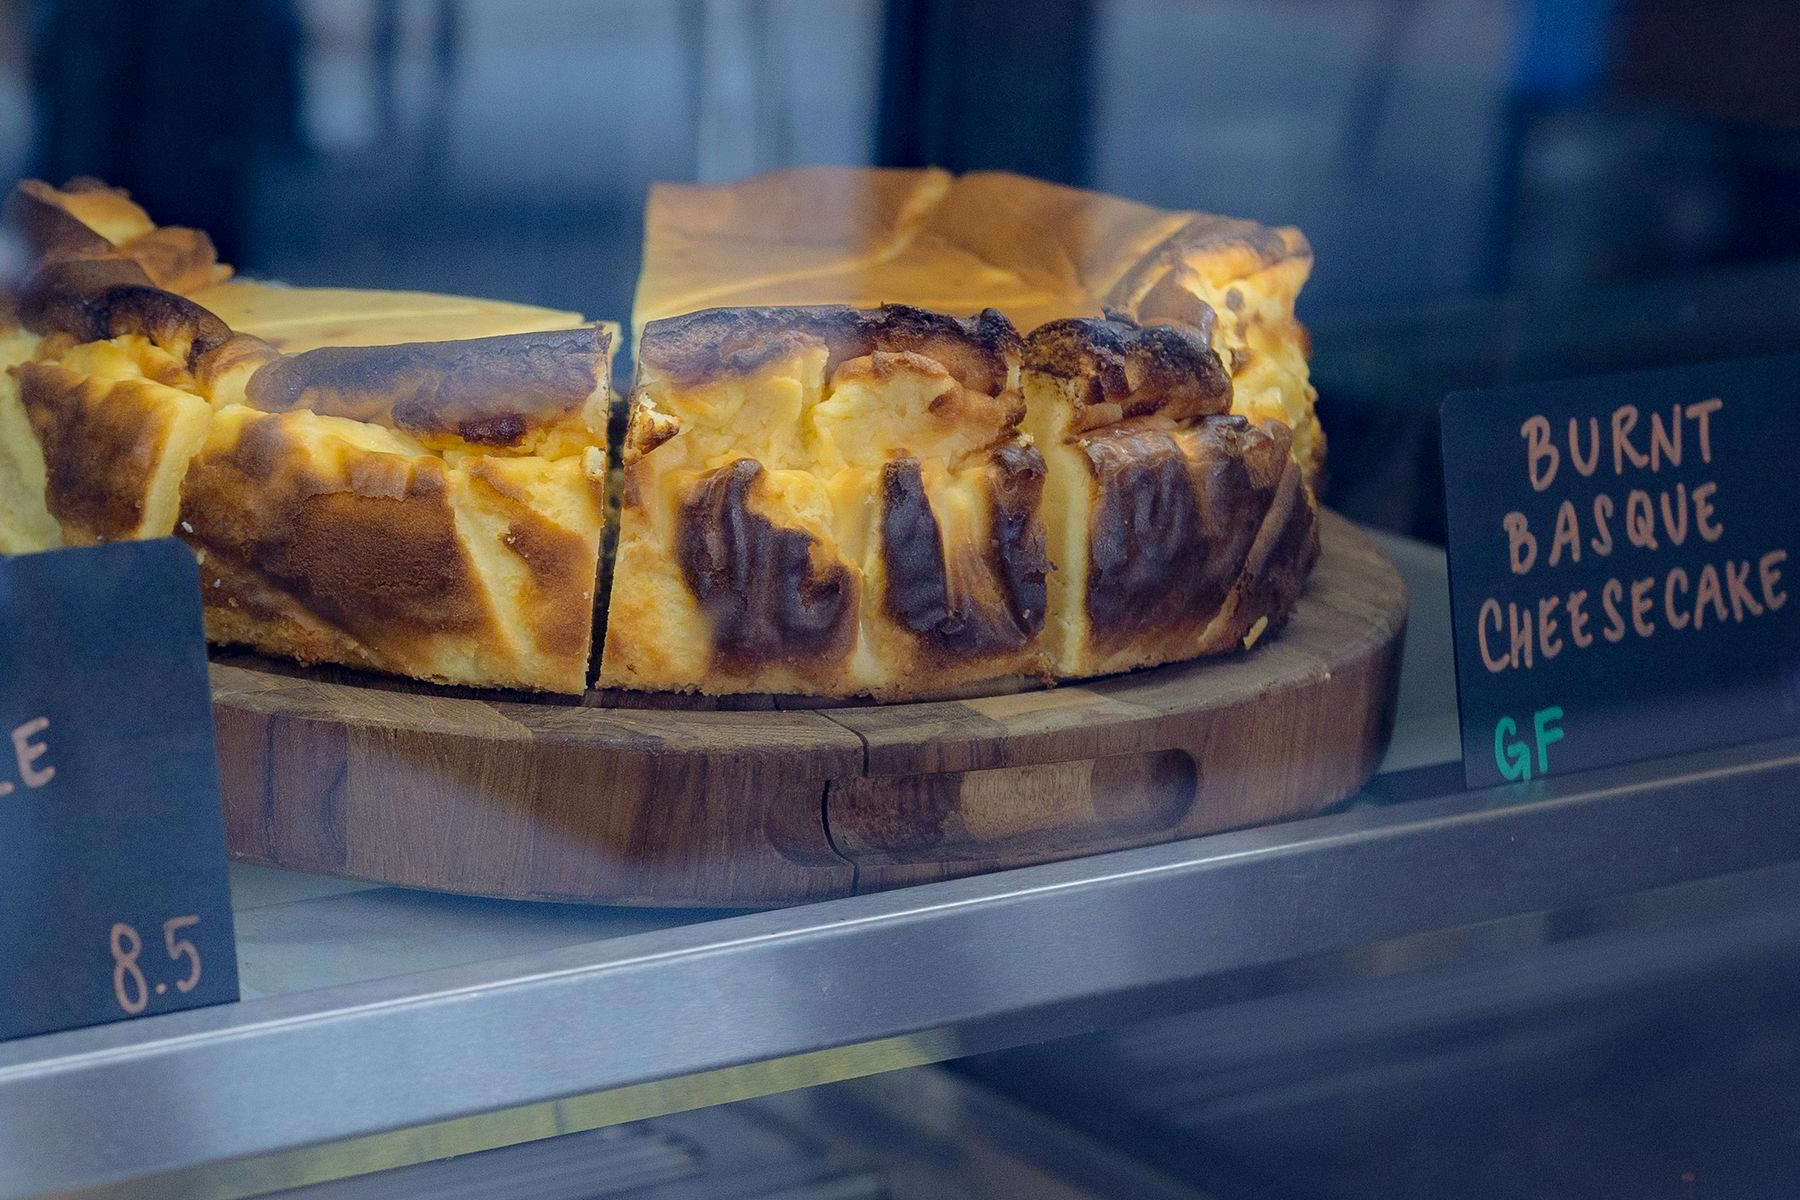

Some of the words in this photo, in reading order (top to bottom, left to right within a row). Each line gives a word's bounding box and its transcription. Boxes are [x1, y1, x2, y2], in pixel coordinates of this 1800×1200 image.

[1520, 398, 1723, 491] BURNT
[1503, 482, 1723, 574] BASQUE
[1478, 550, 1787, 672] CHEESECAKE
[1494, 706, 1564, 784] GF
[110, 915, 201, 1014] 8.5
